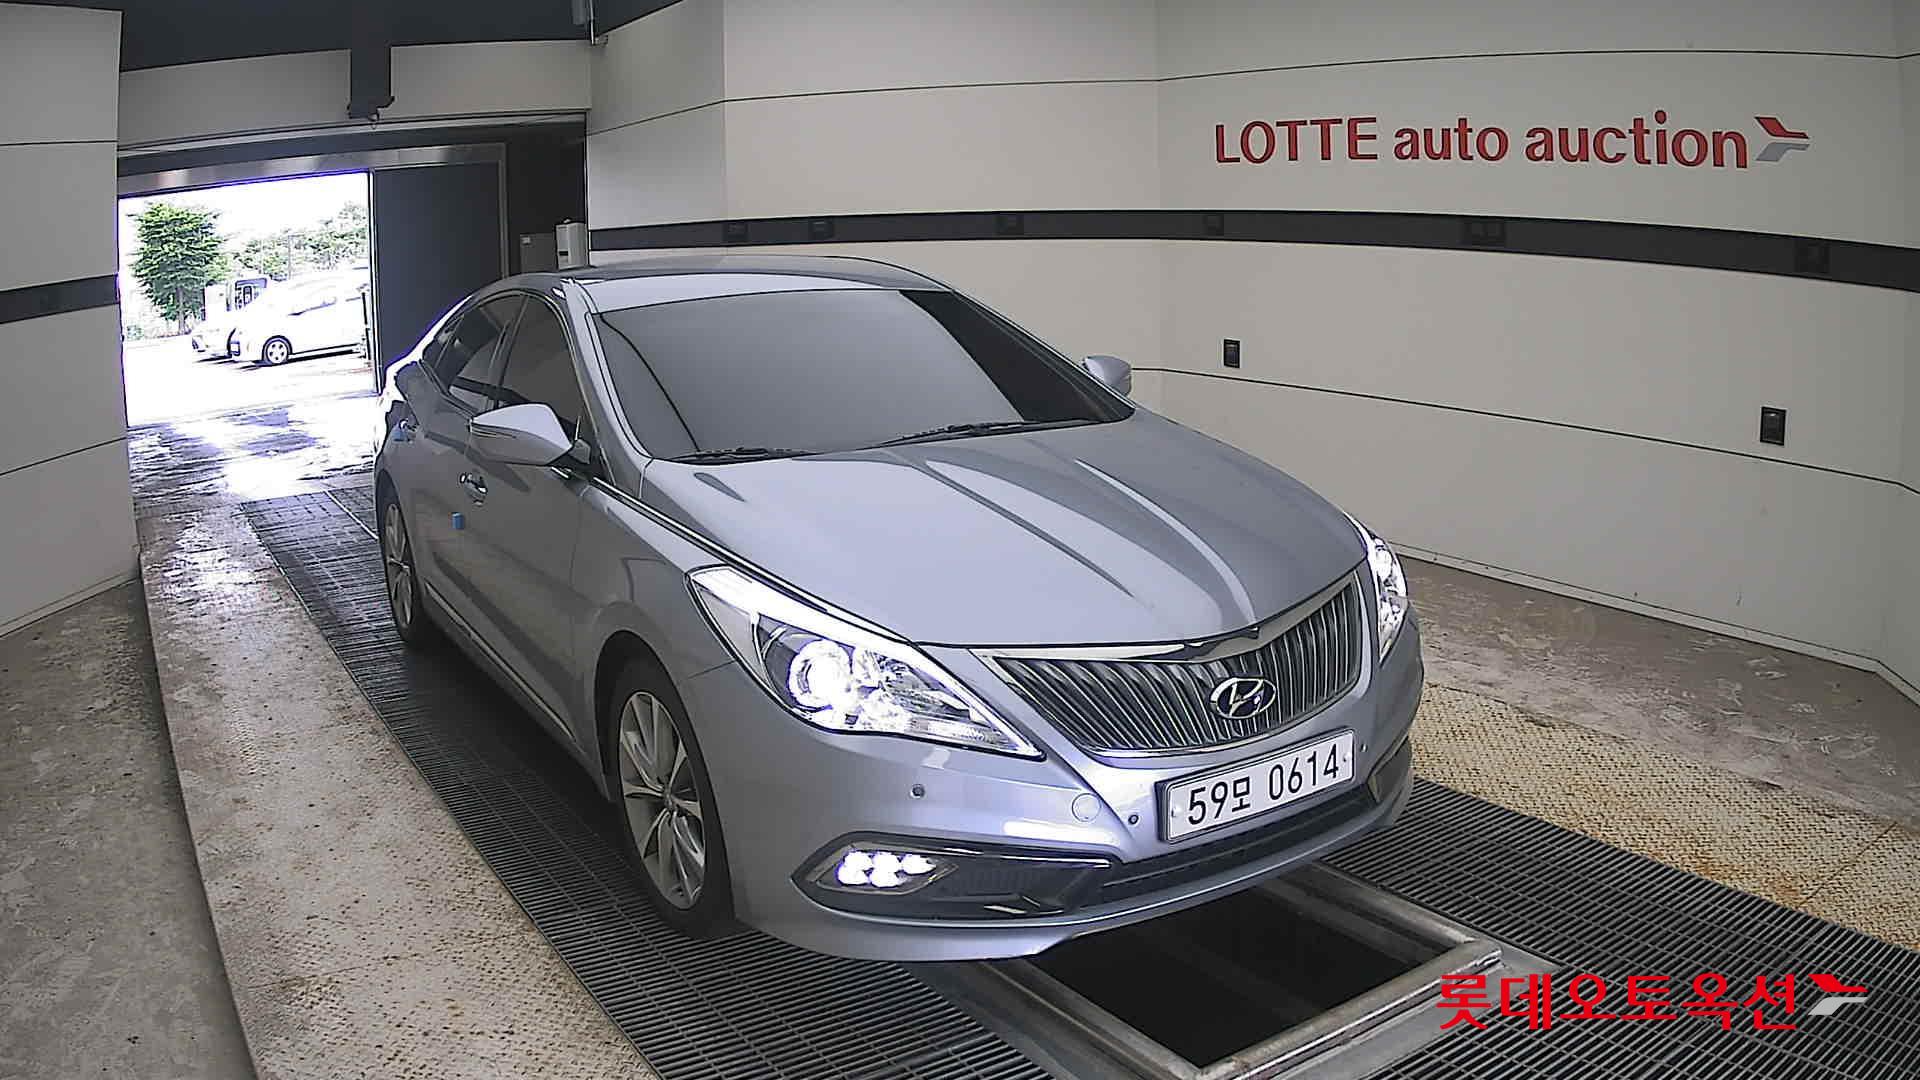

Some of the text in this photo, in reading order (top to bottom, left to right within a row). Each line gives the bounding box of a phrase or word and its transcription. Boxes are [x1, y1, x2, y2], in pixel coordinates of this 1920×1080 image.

[1215, 110, 1748, 169] LOTTE auto auction
[1188, 743, 1339, 825] 59모 0614
